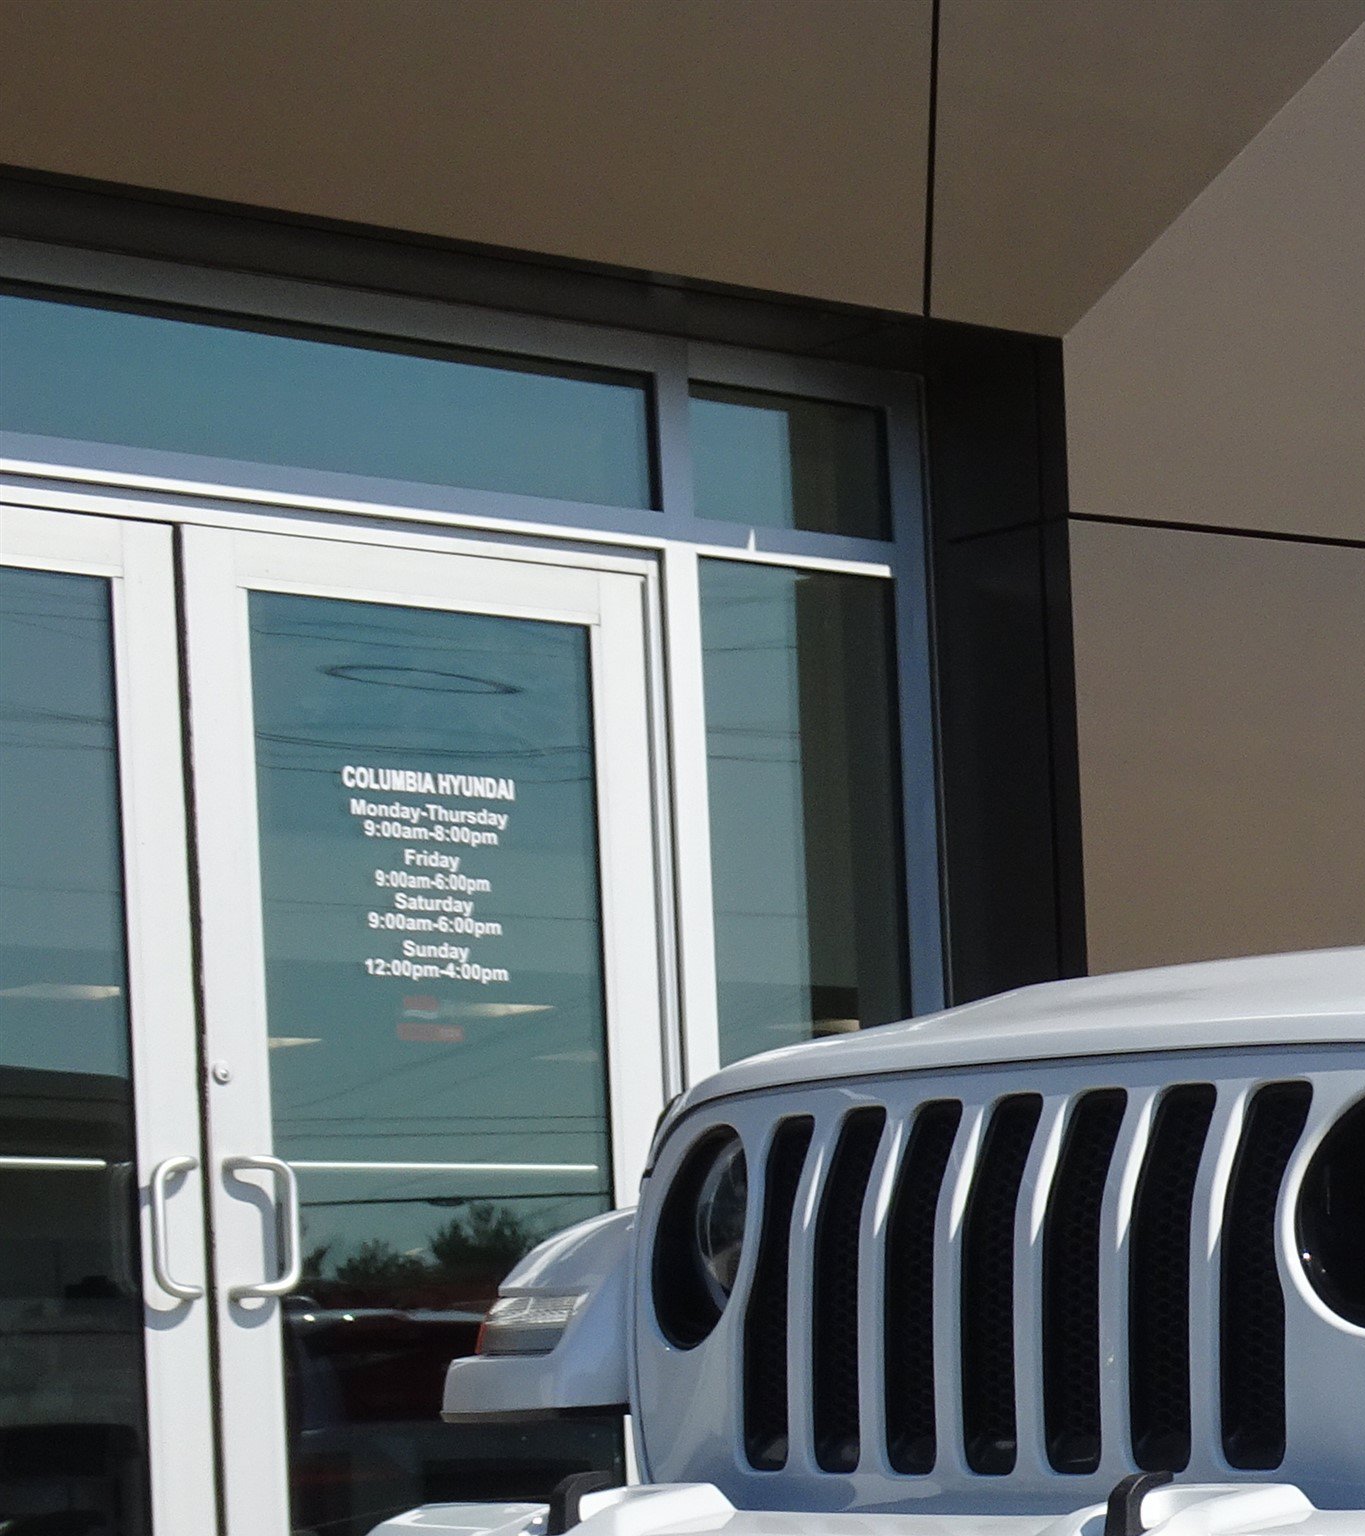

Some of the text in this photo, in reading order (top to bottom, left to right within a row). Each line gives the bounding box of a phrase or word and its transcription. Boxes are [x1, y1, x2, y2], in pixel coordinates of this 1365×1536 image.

[342, 765, 515, 800] COLUMBIA HYUNDAI
[350, 799, 508, 829] Monday-Thursday
[364, 821, 498, 846] 9:00am-8:00pm
[404, 849, 460, 871] Friday
[375, 870, 491, 893] 9:00am-6:00pm
[394, 893, 474, 917] Saturday
[368, 912, 502, 937] 9:00am-6:00pm
[403, 940, 469, 962] Sunday
[365, 958, 509, 984] 12:00pm-4:00pm
